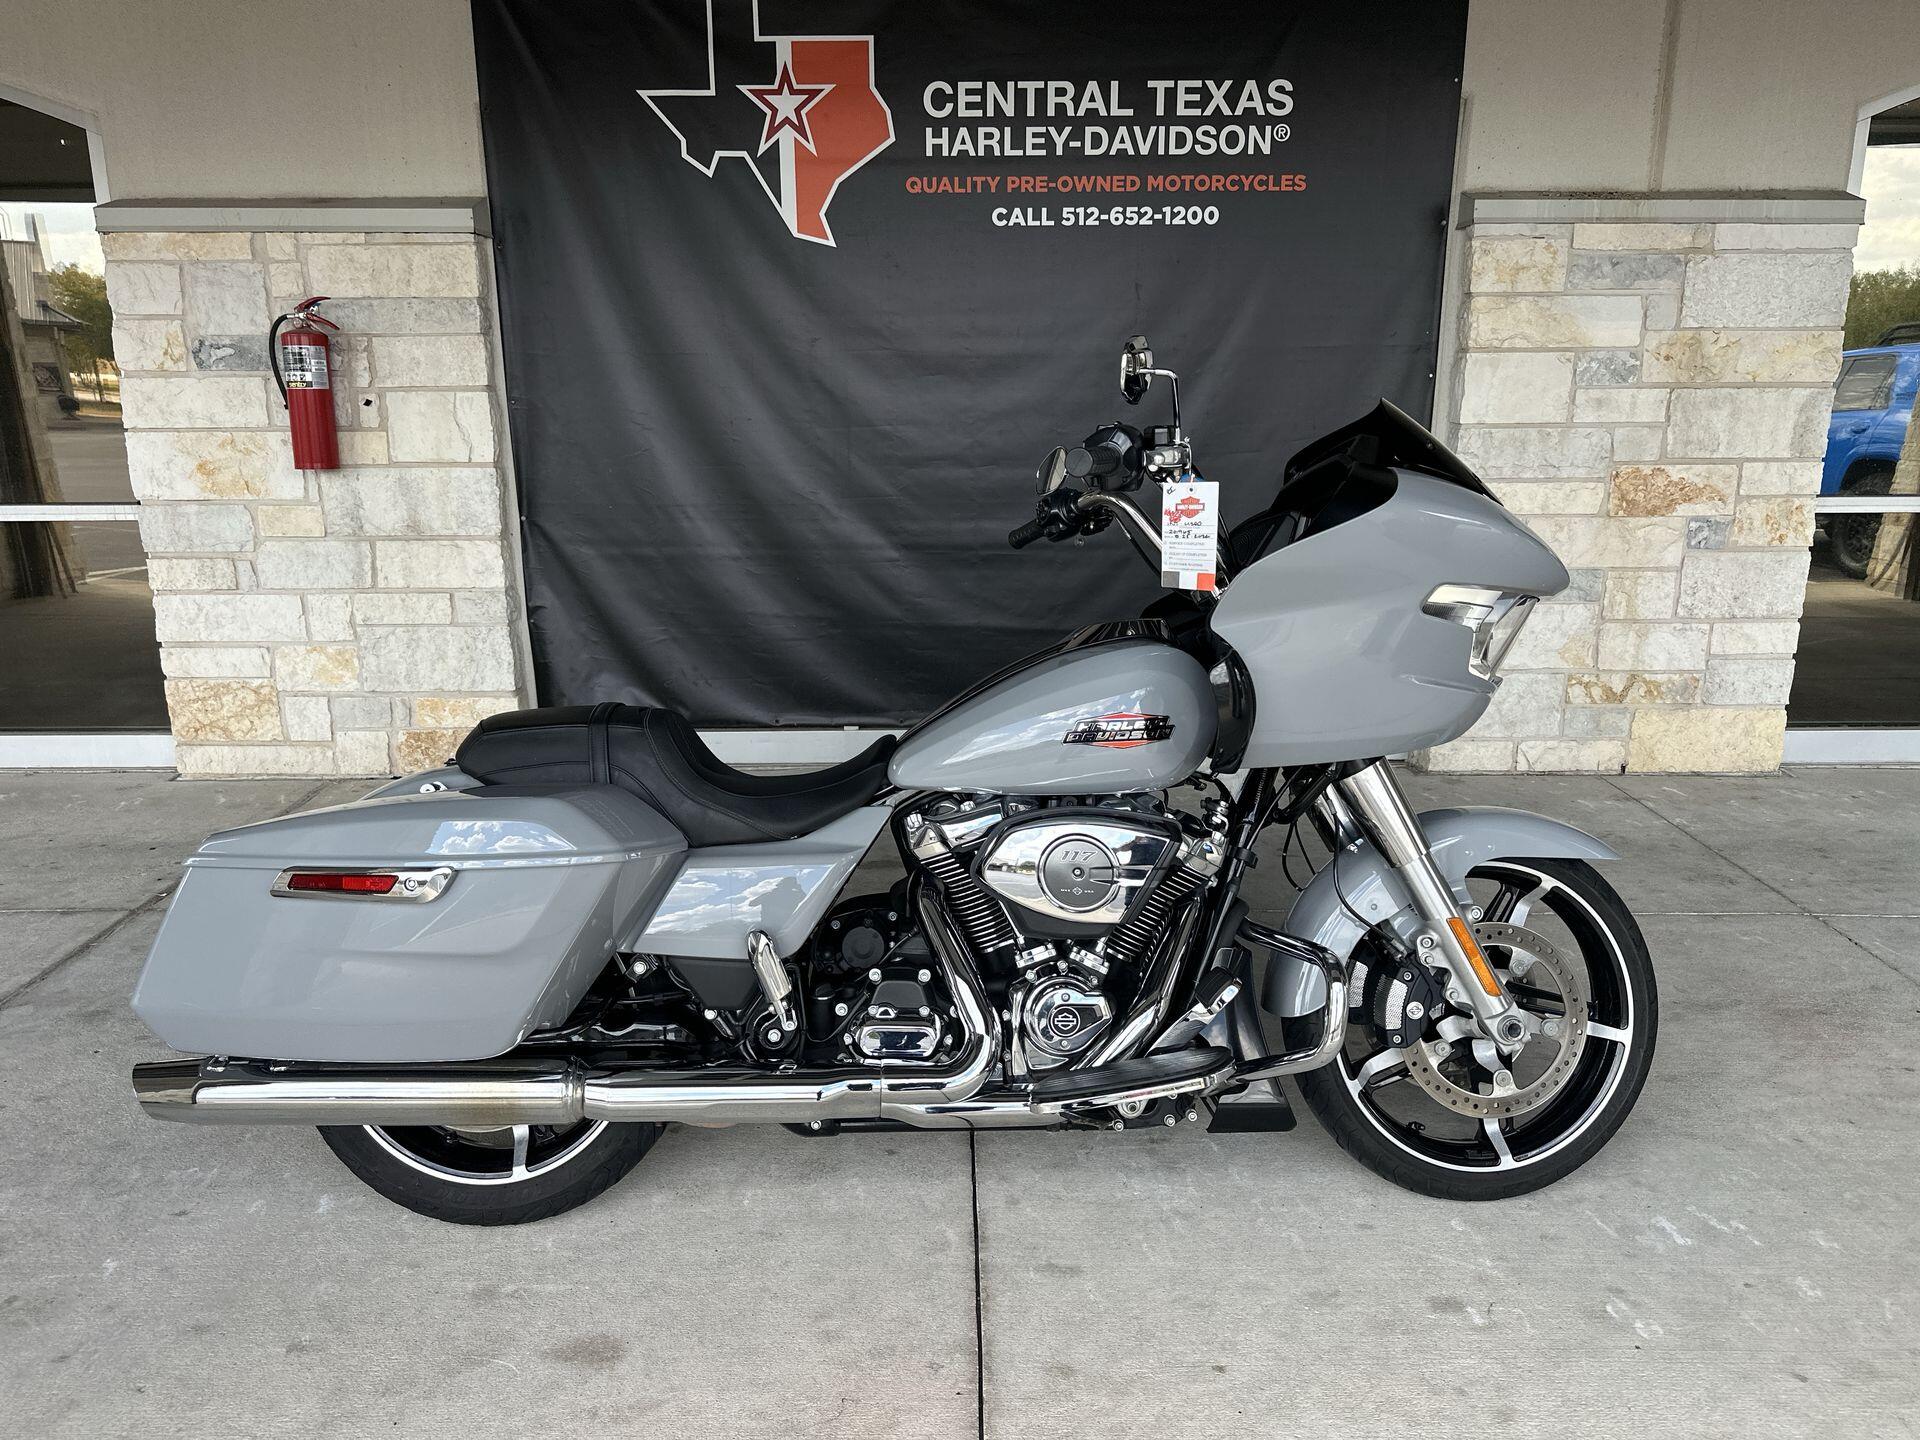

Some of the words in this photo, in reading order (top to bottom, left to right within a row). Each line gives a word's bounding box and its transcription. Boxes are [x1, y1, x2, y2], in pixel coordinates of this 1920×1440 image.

[922, 80, 1134, 119] CENTRAL
[1147, 78, 1294, 117] TEXAS
[905, 176, 1000, 195] QUALITY
[1006, 175, 1140, 193] PRE-OWNED
[1147, 174, 1307, 193] MOTORCYCLES
[991, 207, 1055, 227] CALL
[1060, 205, 1220, 227] 512-652-1200
[1065, 727, 1173, 742] DAVIDSON
[1060, 850, 1098, 864] 117
